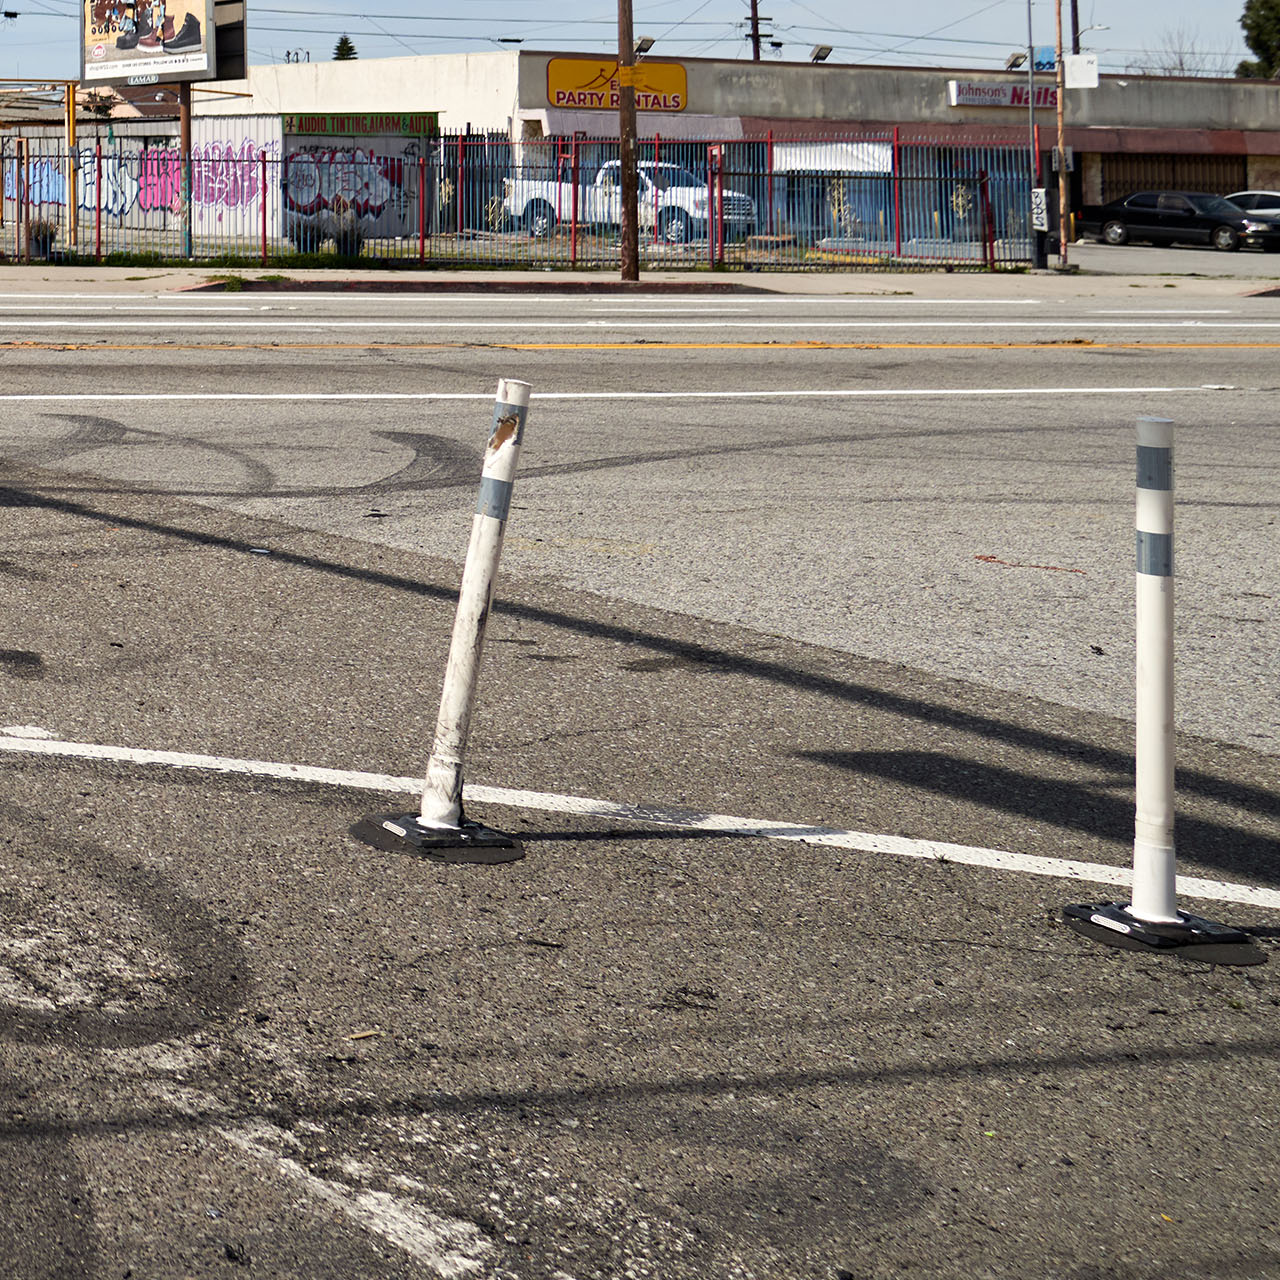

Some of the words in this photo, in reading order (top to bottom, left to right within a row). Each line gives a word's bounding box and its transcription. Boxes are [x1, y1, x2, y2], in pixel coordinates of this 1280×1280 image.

[130, 75, 157, 85] LAMAR
[555, 90, 606, 107] PARTY
[609, 93, 681, 109] RNTALS
[957, 83, 1007, 99] Johnson's
[1010, 85, 1058, 106] Nails
[402, 115, 409, 131] &
[409, 115, 434, 133] AUTO
